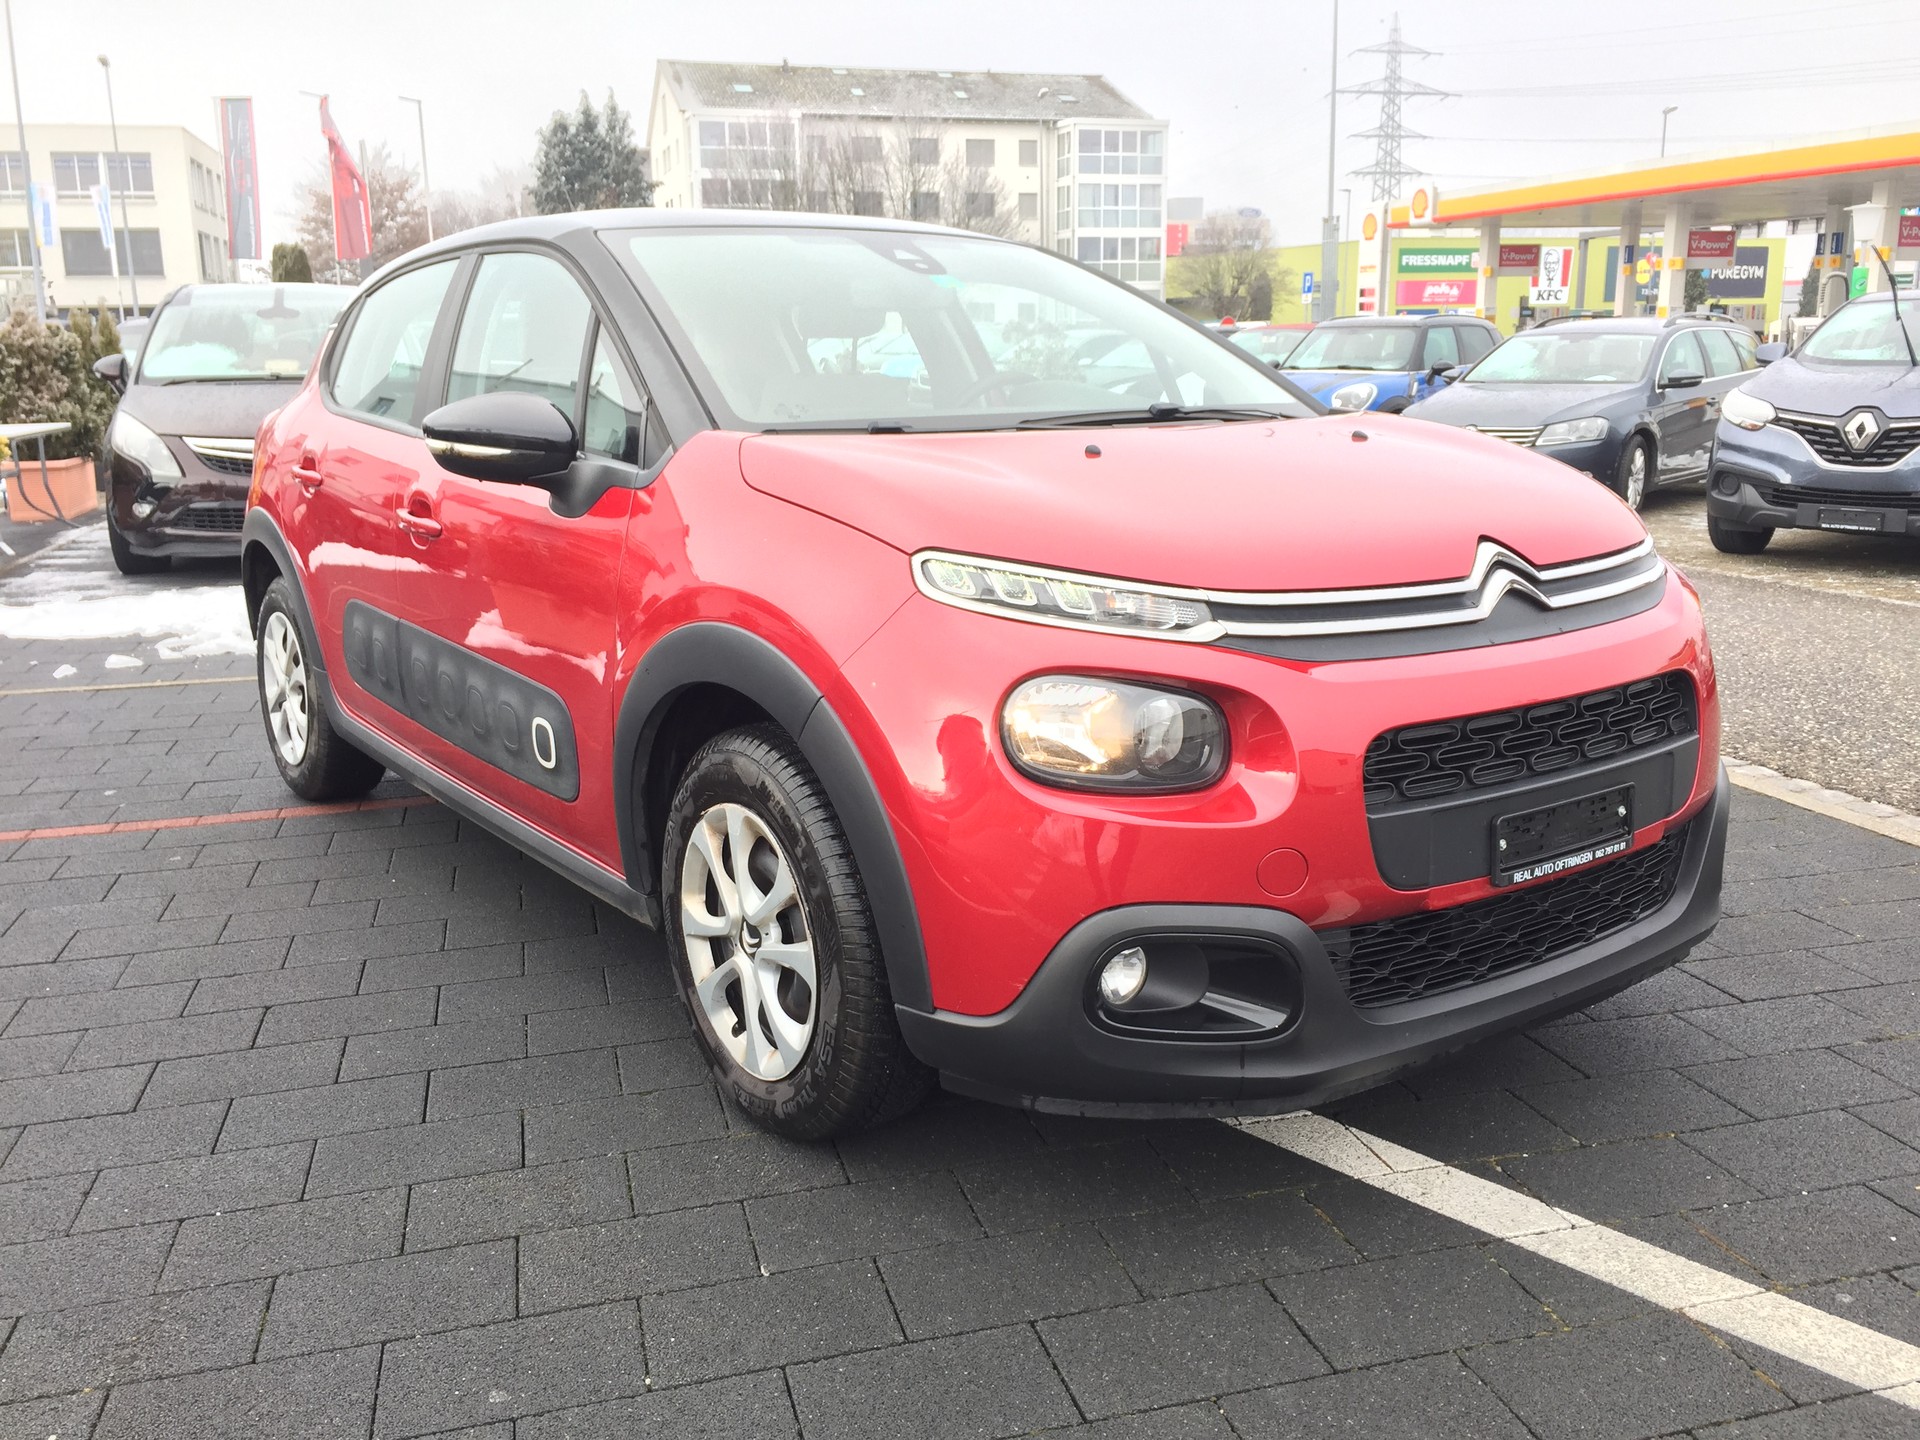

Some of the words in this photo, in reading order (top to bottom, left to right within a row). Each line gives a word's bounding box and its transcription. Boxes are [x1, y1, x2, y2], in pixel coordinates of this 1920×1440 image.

[1902, 226, 1920, 237] V-P
[1401, 254, 1469, 266] FRESSNAPF
[1711, 265, 1764, 279] PUREGYM
[1535, 289, 1563, 301] KFC
[1513, 868, 1532, 883] REAL
[1534, 863, 1554, 878] AUTO
[1555, 850, 1594, 872] OFTRINGEN
[814, 1021, 836, 1078] ESA
